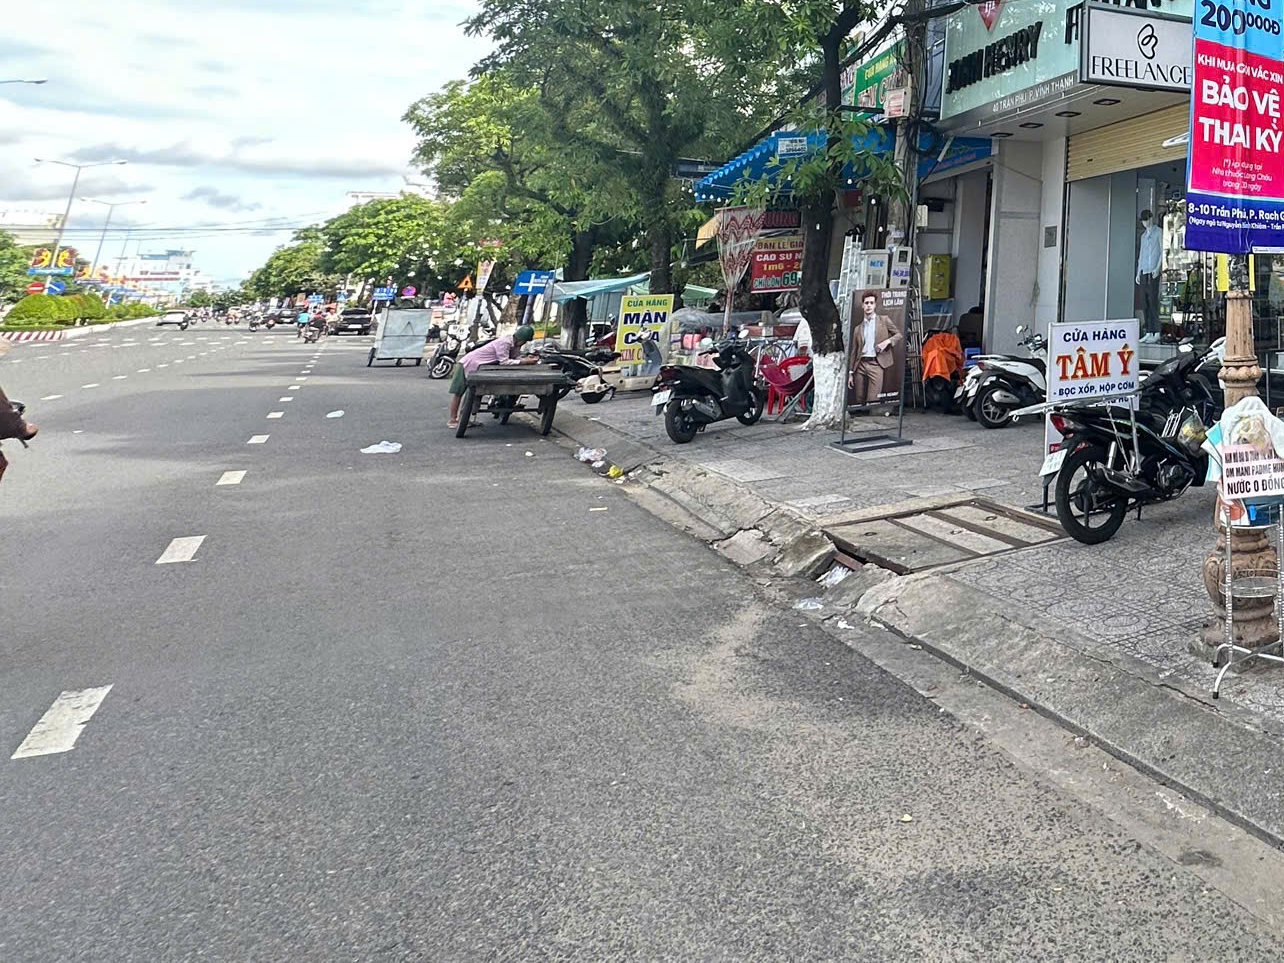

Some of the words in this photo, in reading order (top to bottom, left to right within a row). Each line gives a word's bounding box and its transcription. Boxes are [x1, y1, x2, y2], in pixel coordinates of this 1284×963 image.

[1198, 53, 1216, 68] KHI
[1217, 57, 1236, 73] MUA
[1270, 71, 1284, 85] XIN
[1202, 75, 1249, 112] BẢO
[1252, 88, 1281, 124] VỆ
[1198, 117, 1251, 150] THAI
[1188, 202, 1210, 215] 8-10
[1210, 205, 1230, 218] Trần
[1249, 210, 1258, 220] P.
[1258, 210, 1279, 223] Rạch
[756, 253, 776, 261] CAO
[627, 297, 643, 307] CỬA
[646, 299, 668, 307] HÀNG
[623, 309, 667, 325] MÀN
[624, 331, 659, 344] CA
[1063, 328, 1089, 342] CỬA
[1093, 327, 1127, 341] HÀNG
[1056, 346, 1111, 381] TÂM
[1117, 343, 1134, 375] Ý
[1059, 387, 1076, 397] BỌC
[1099, 382, 1116, 393] HỘP
[1117, 381, 1134, 389] CƠM
[1227, 478, 1251, 495] NƯỚC
